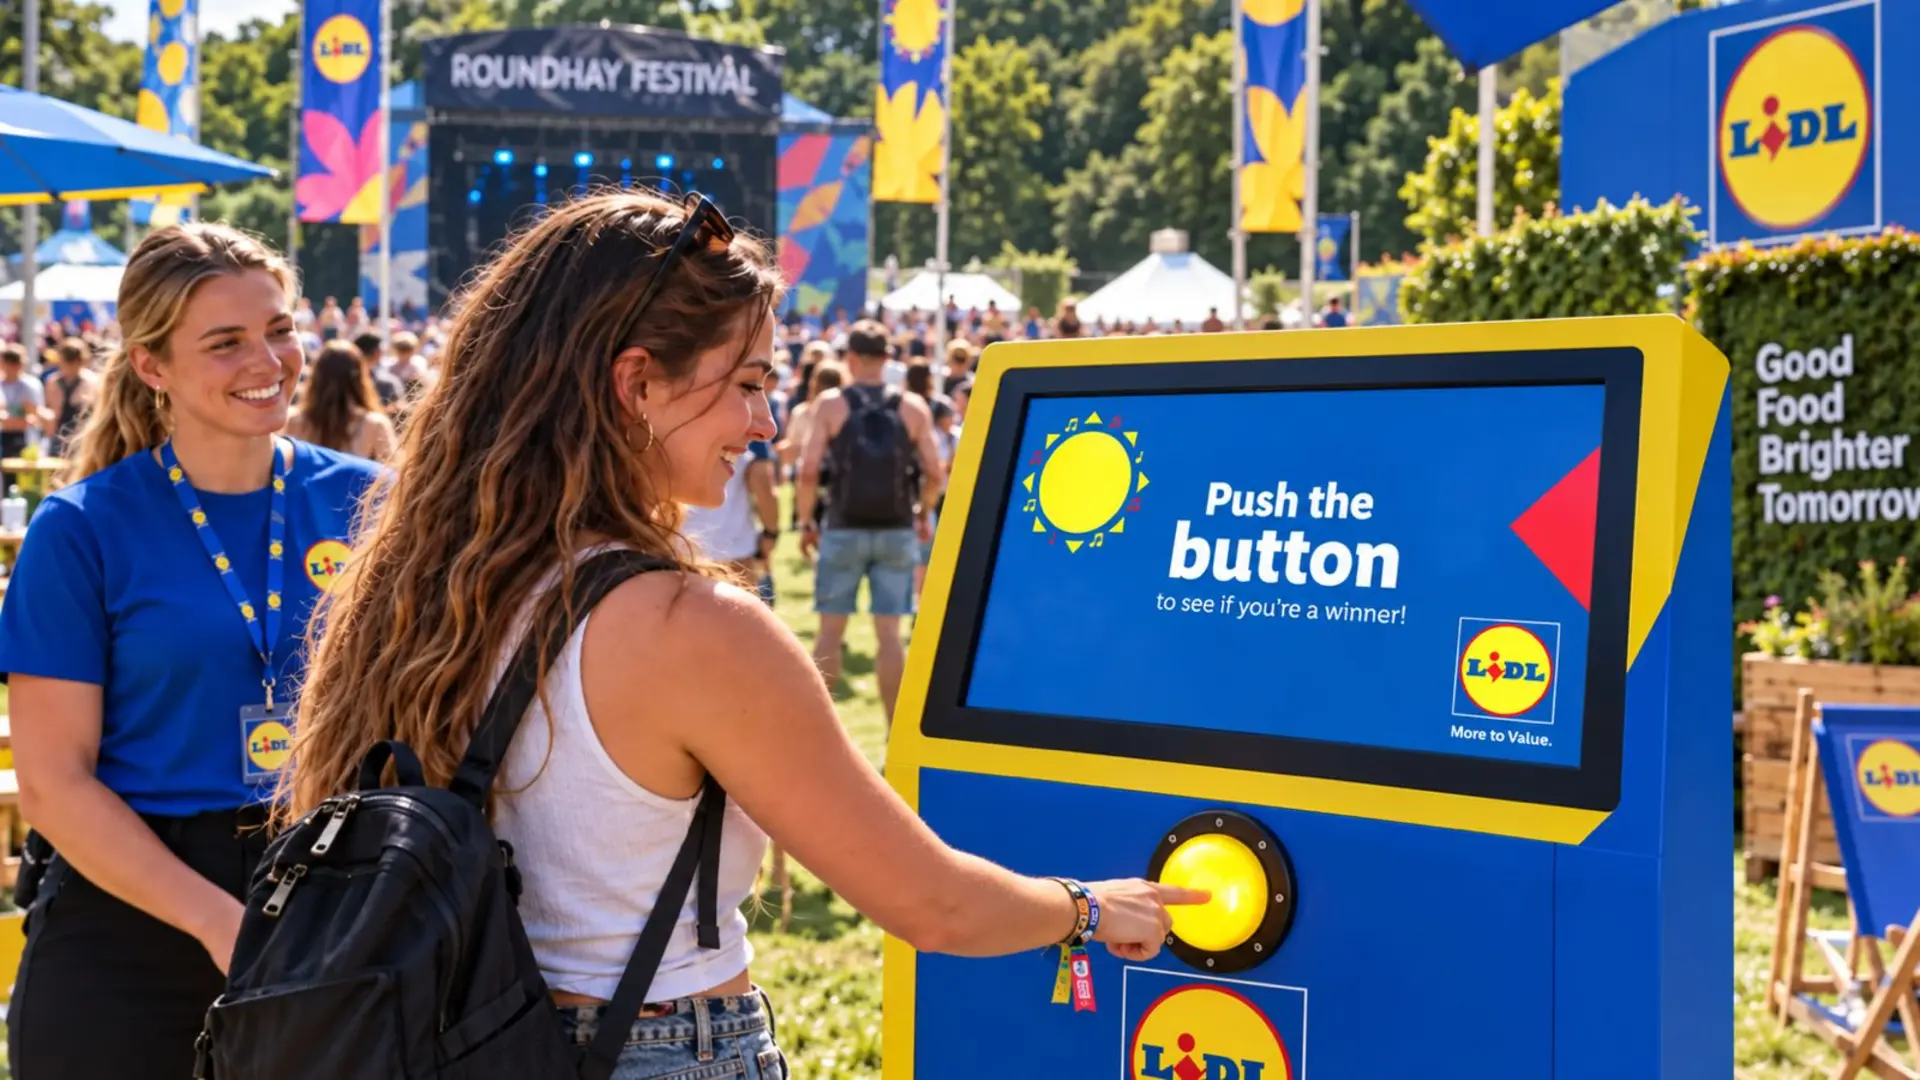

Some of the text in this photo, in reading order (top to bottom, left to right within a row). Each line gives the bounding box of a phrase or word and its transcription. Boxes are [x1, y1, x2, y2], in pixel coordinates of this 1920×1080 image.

[450, 53, 756, 97] ROUNDHAY FESTIVAL
[1729, 95, 1857, 162] LiDL
[1756, 333, 1854, 383] Good
[1757, 381, 1844, 428] Food
[1759, 428, 1910, 481] Brighter
[1206, 481, 1374, 520] Push the
[310, 556, 346, 577] LiD
[1168, 519, 1400, 589] button
[1156, 593, 1406, 625] to see if you're a winner!
[1466, 651, 1545, 683] LiDL
[1450, 724, 1553, 748] More to Value.
